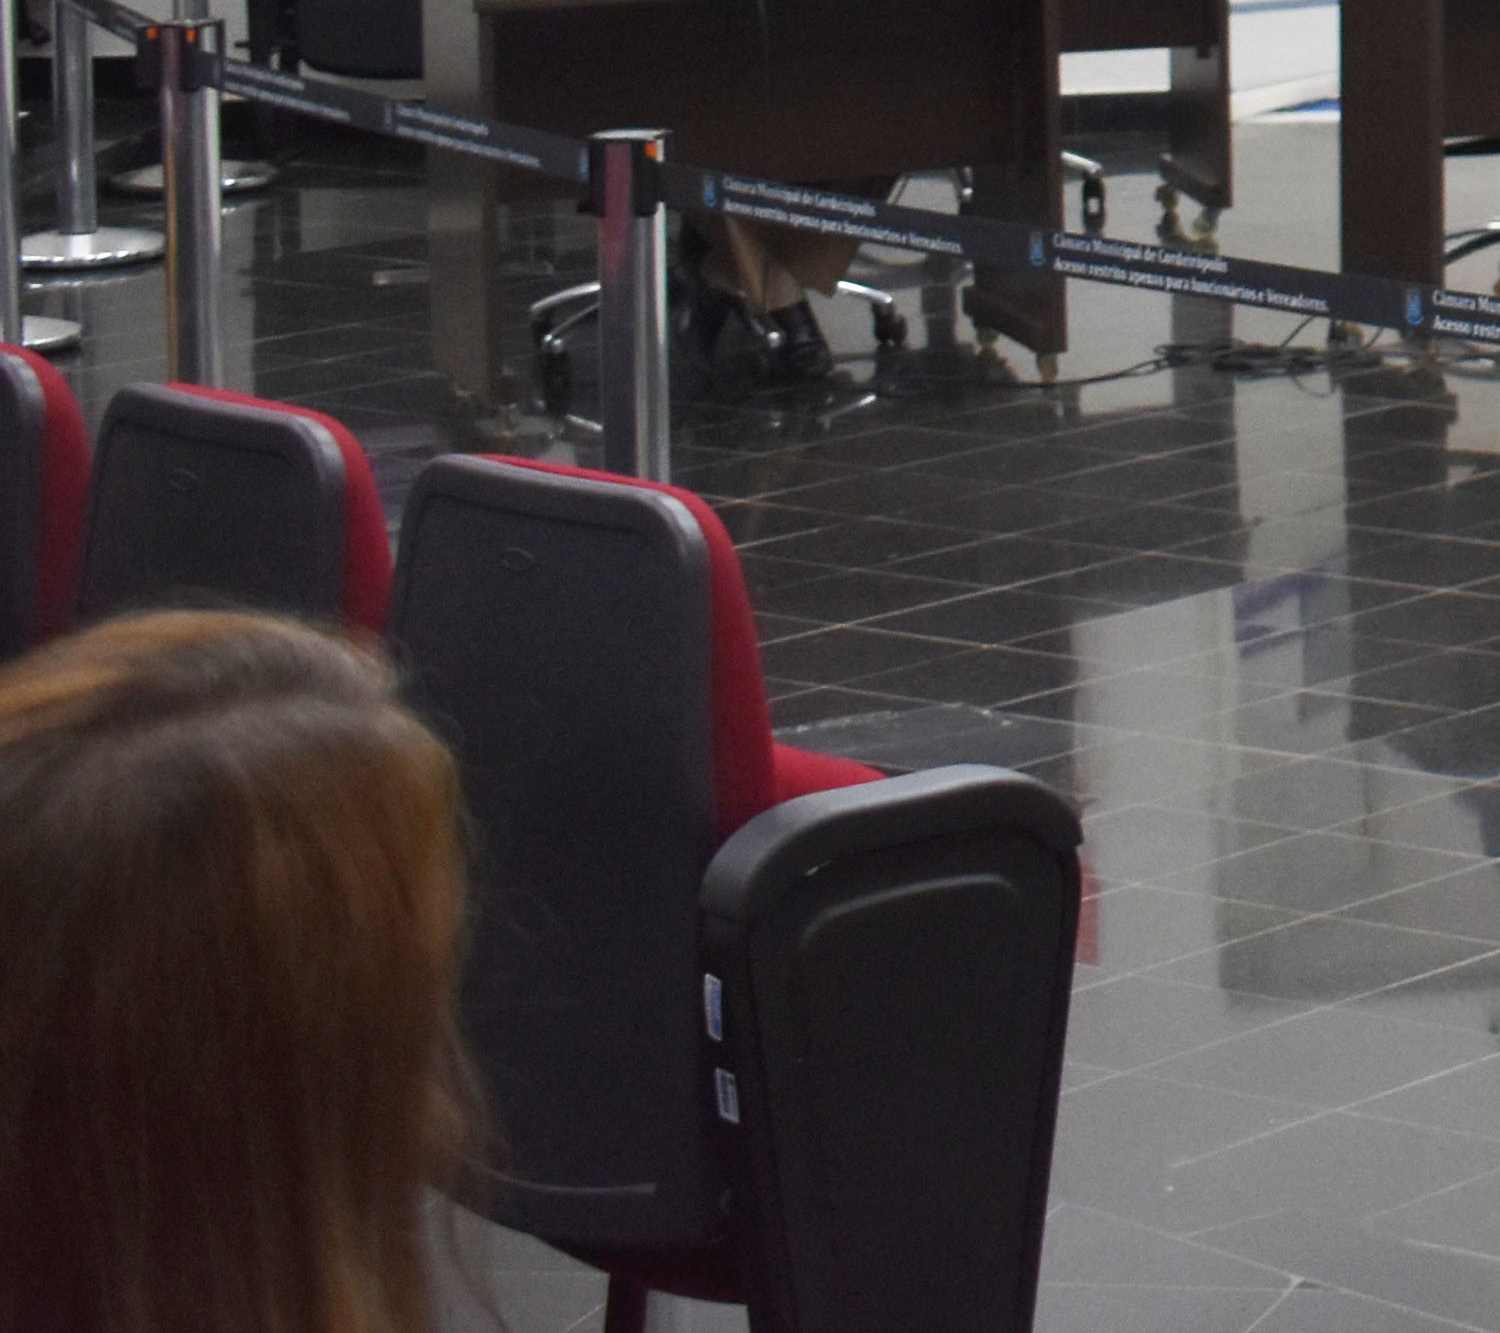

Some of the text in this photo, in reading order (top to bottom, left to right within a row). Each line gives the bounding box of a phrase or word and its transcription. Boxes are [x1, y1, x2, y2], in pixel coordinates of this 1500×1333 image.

[1053, 232, 1092, 252] Câmara
[1093, 238, 1142, 262] Municipal
[1145, 247, 1157, 263] de
[1053, 256, 1088, 274] Acesso
[1432, 288, 1477, 311] Câmara
[1432, 314, 1472, 335] Acesso
